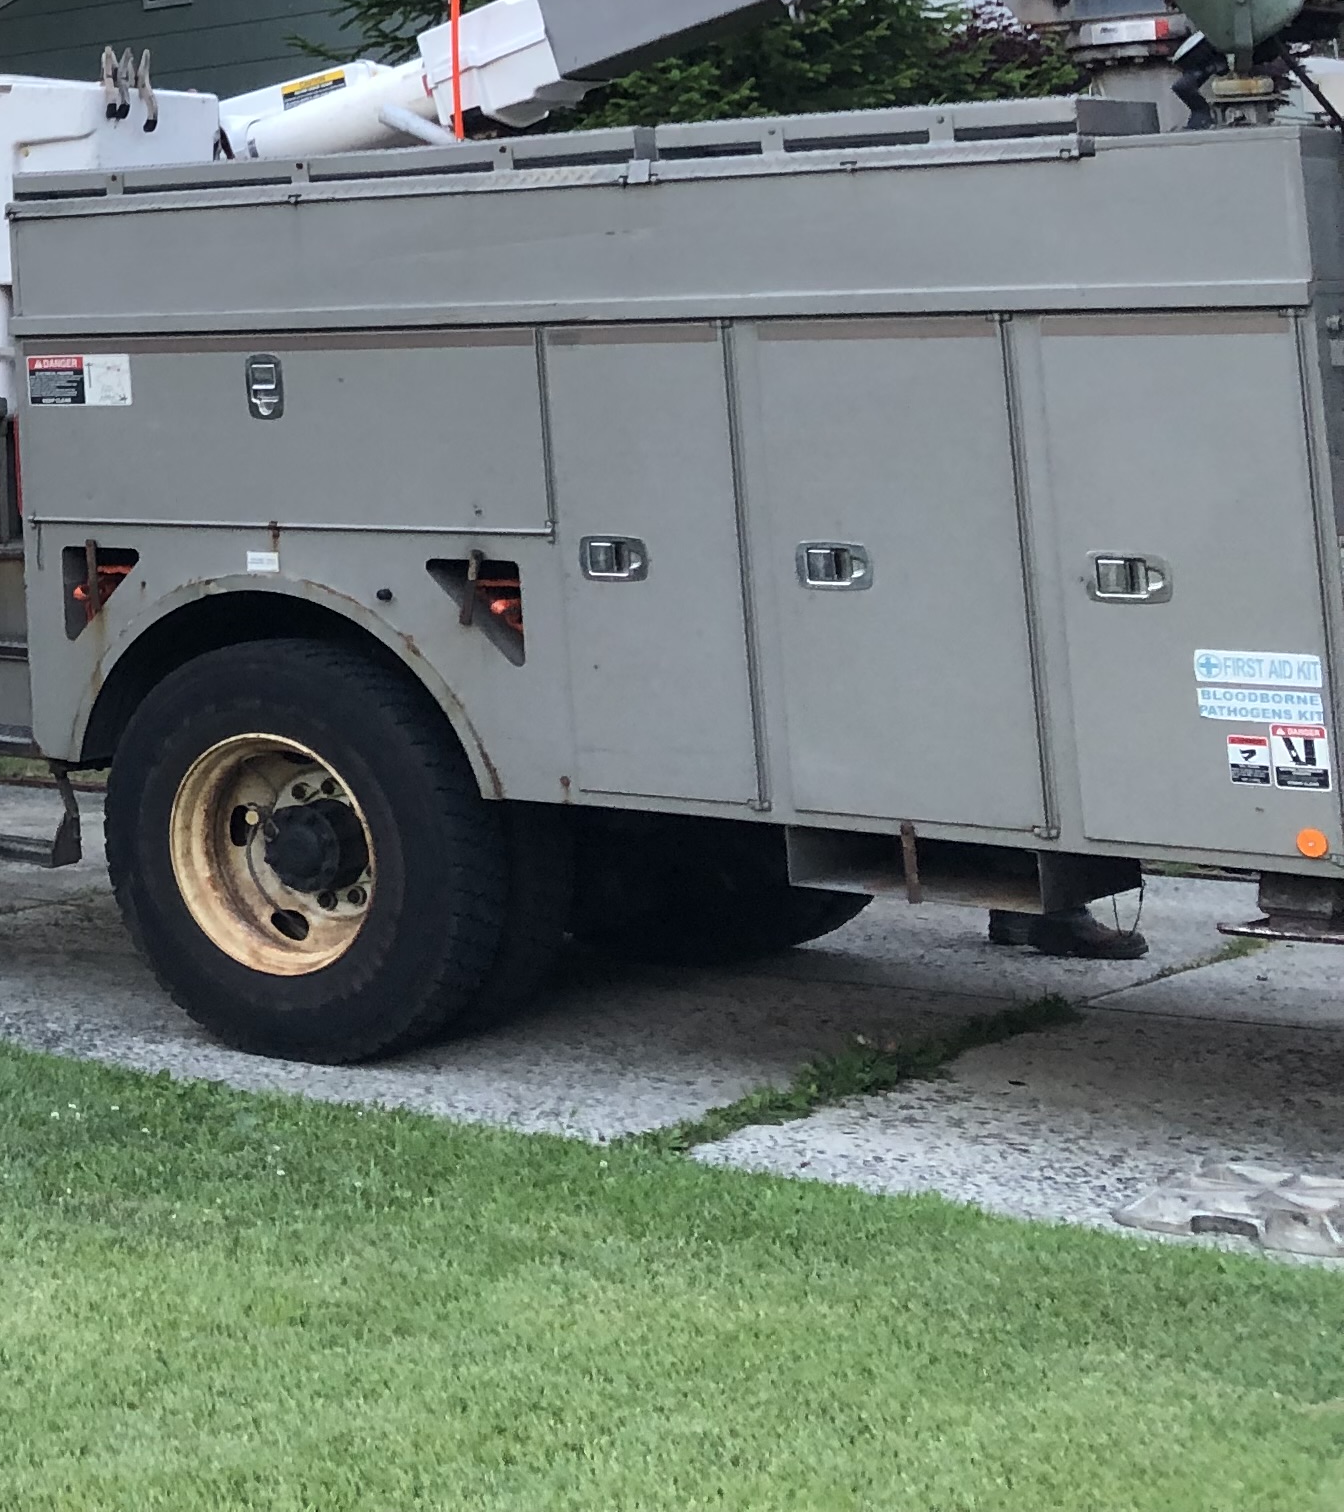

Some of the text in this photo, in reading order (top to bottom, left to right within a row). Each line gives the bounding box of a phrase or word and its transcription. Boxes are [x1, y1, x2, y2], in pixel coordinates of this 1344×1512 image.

[43, 358, 78, 368] DANGER
[1223, 656, 1320, 681] FIRST AID KIT
[1201, 689, 1321, 706] BLOODBORNE
[1200, 704, 1323, 722] PATHOGENS KIT
[1287, 727, 1320, 737] DANGER
